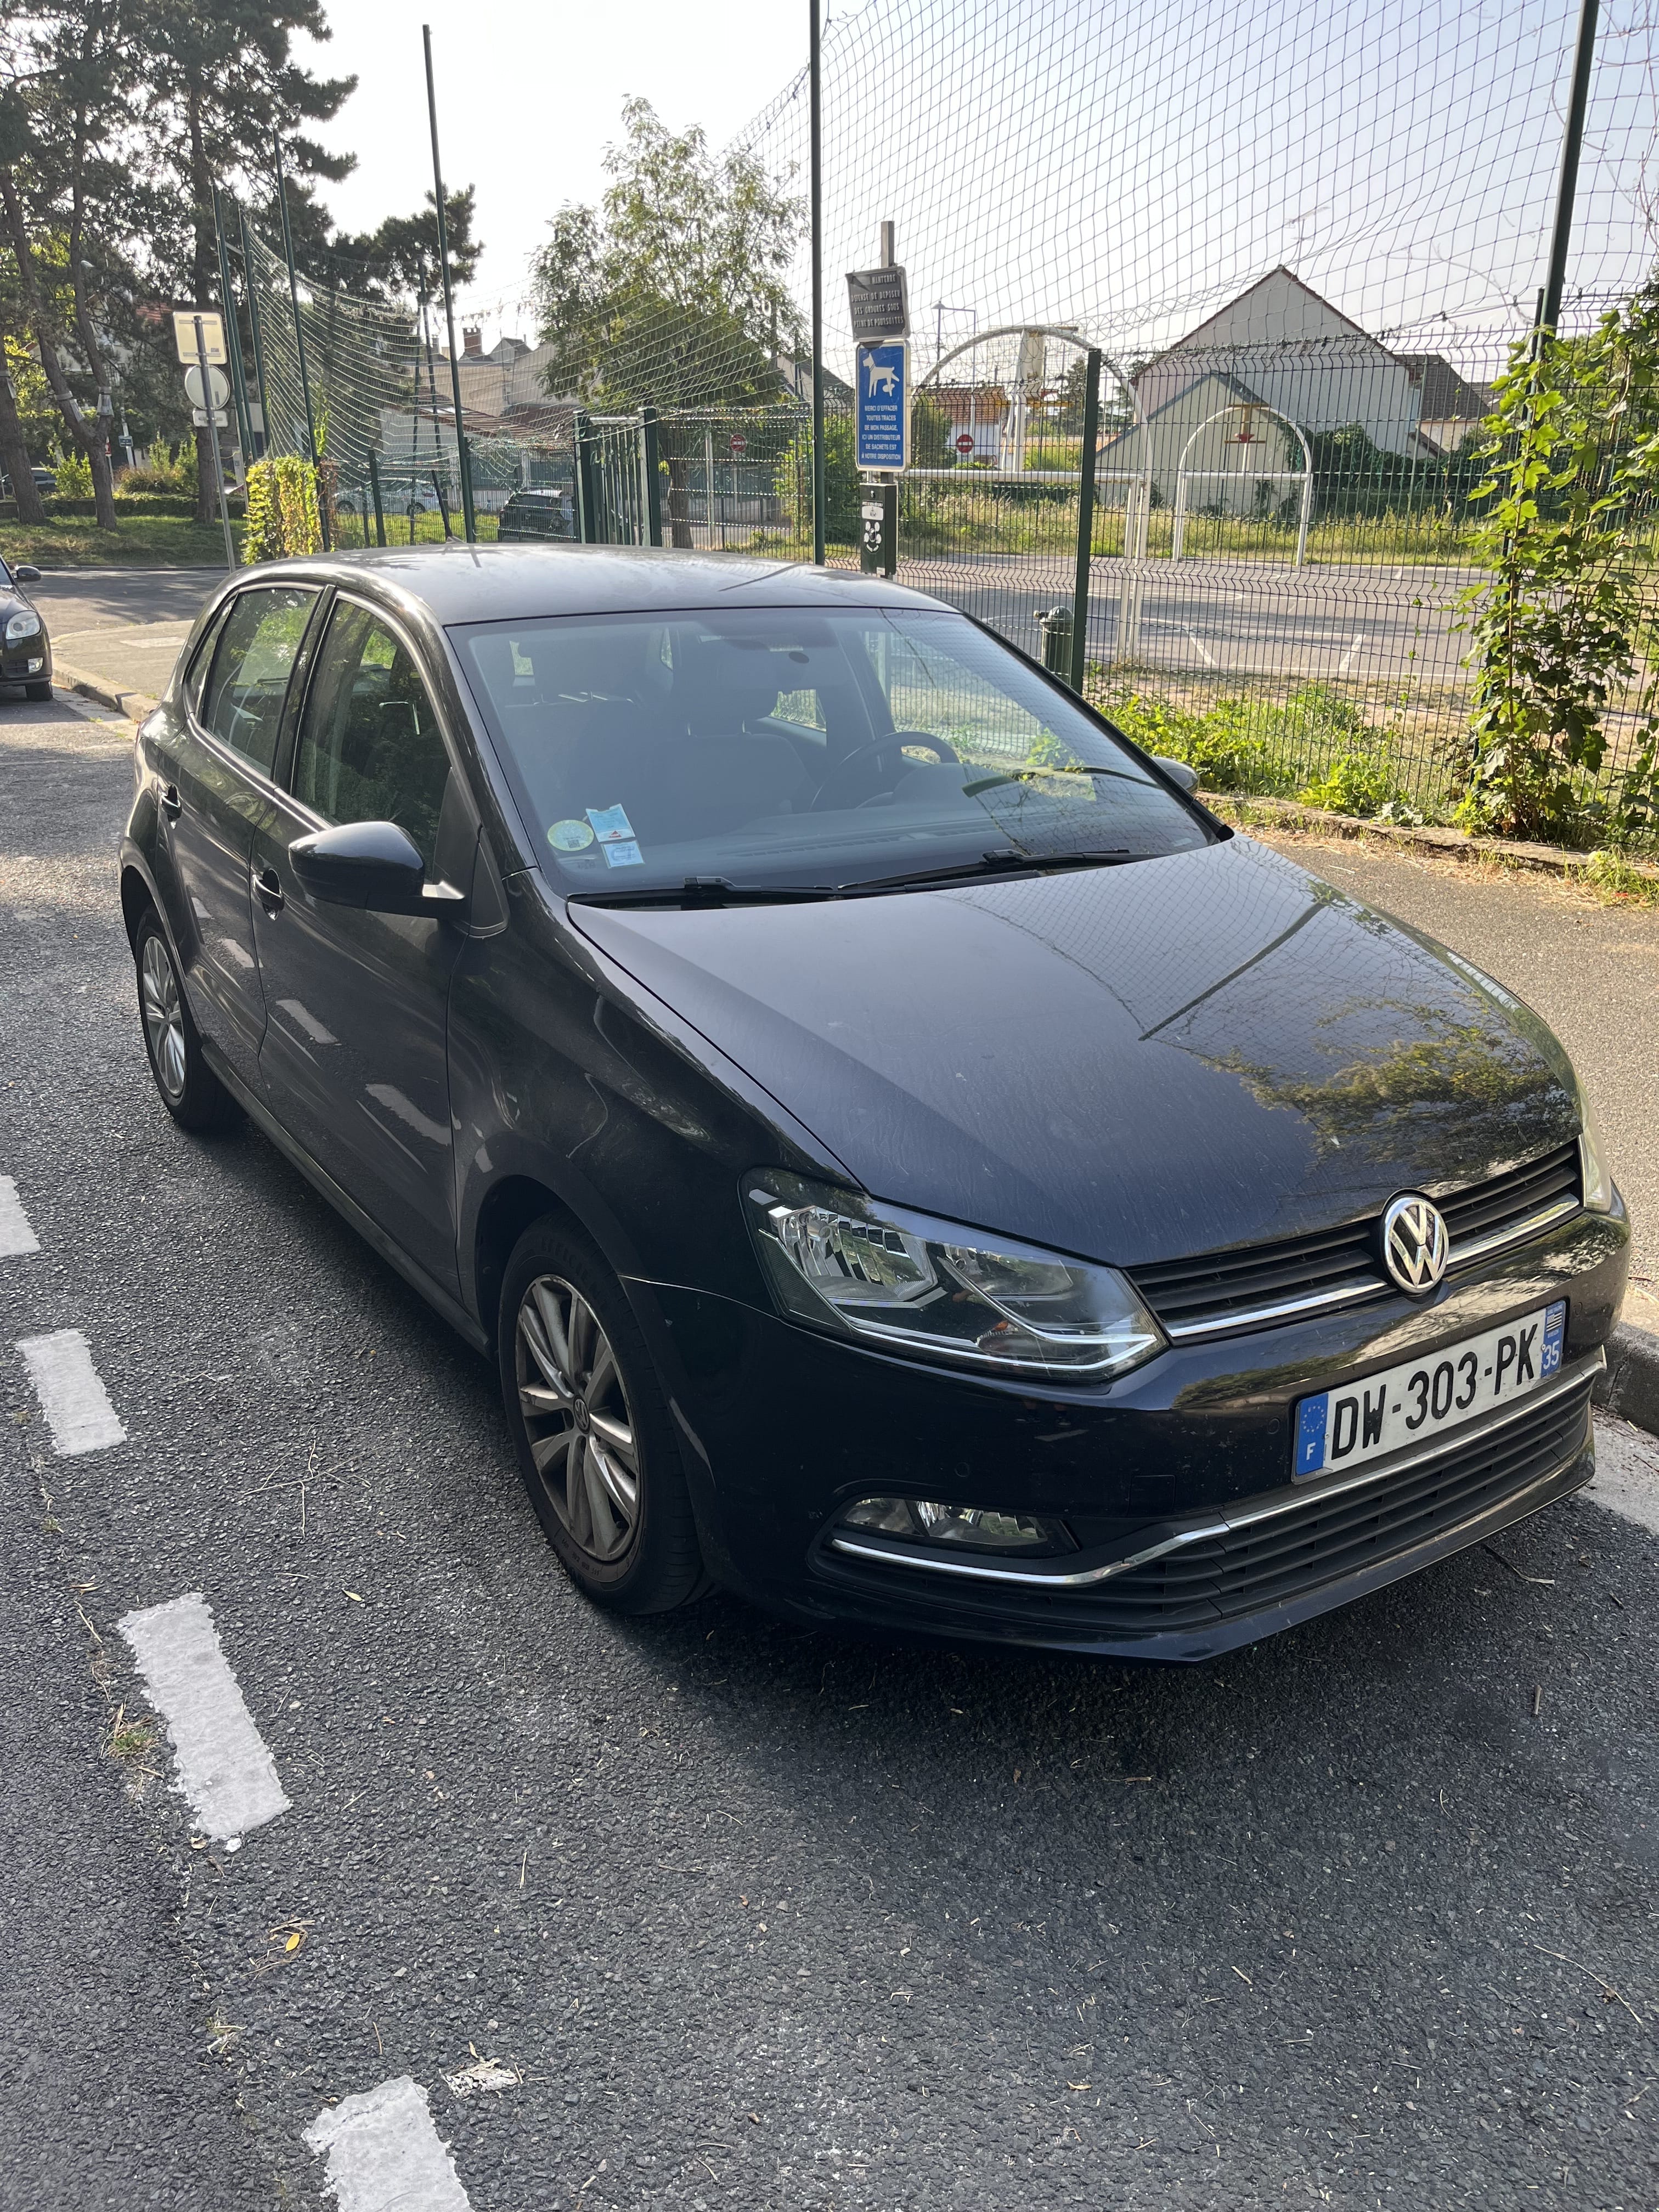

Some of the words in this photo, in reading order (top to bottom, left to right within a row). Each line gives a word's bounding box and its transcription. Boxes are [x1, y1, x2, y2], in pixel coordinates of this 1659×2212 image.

[872, 274, 895, 284] NANTERRE
[851, 293, 868, 302] DEFENSE
[871, 292, 877, 300] DE
[879, 290, 900, 299] DEPOSER
[865, 304, 884, 314] ORDURES
[888, 303, 899, 311] SOUS
[867, 319, 873, 327] DE
[874, 316, 904, 326] POURSUITES
[1543, 1340, 1560, 1370] 35
[1331, 1323, 1538, 1460] DW-303-PK
[1306, 1442, 1317, 1460] F
